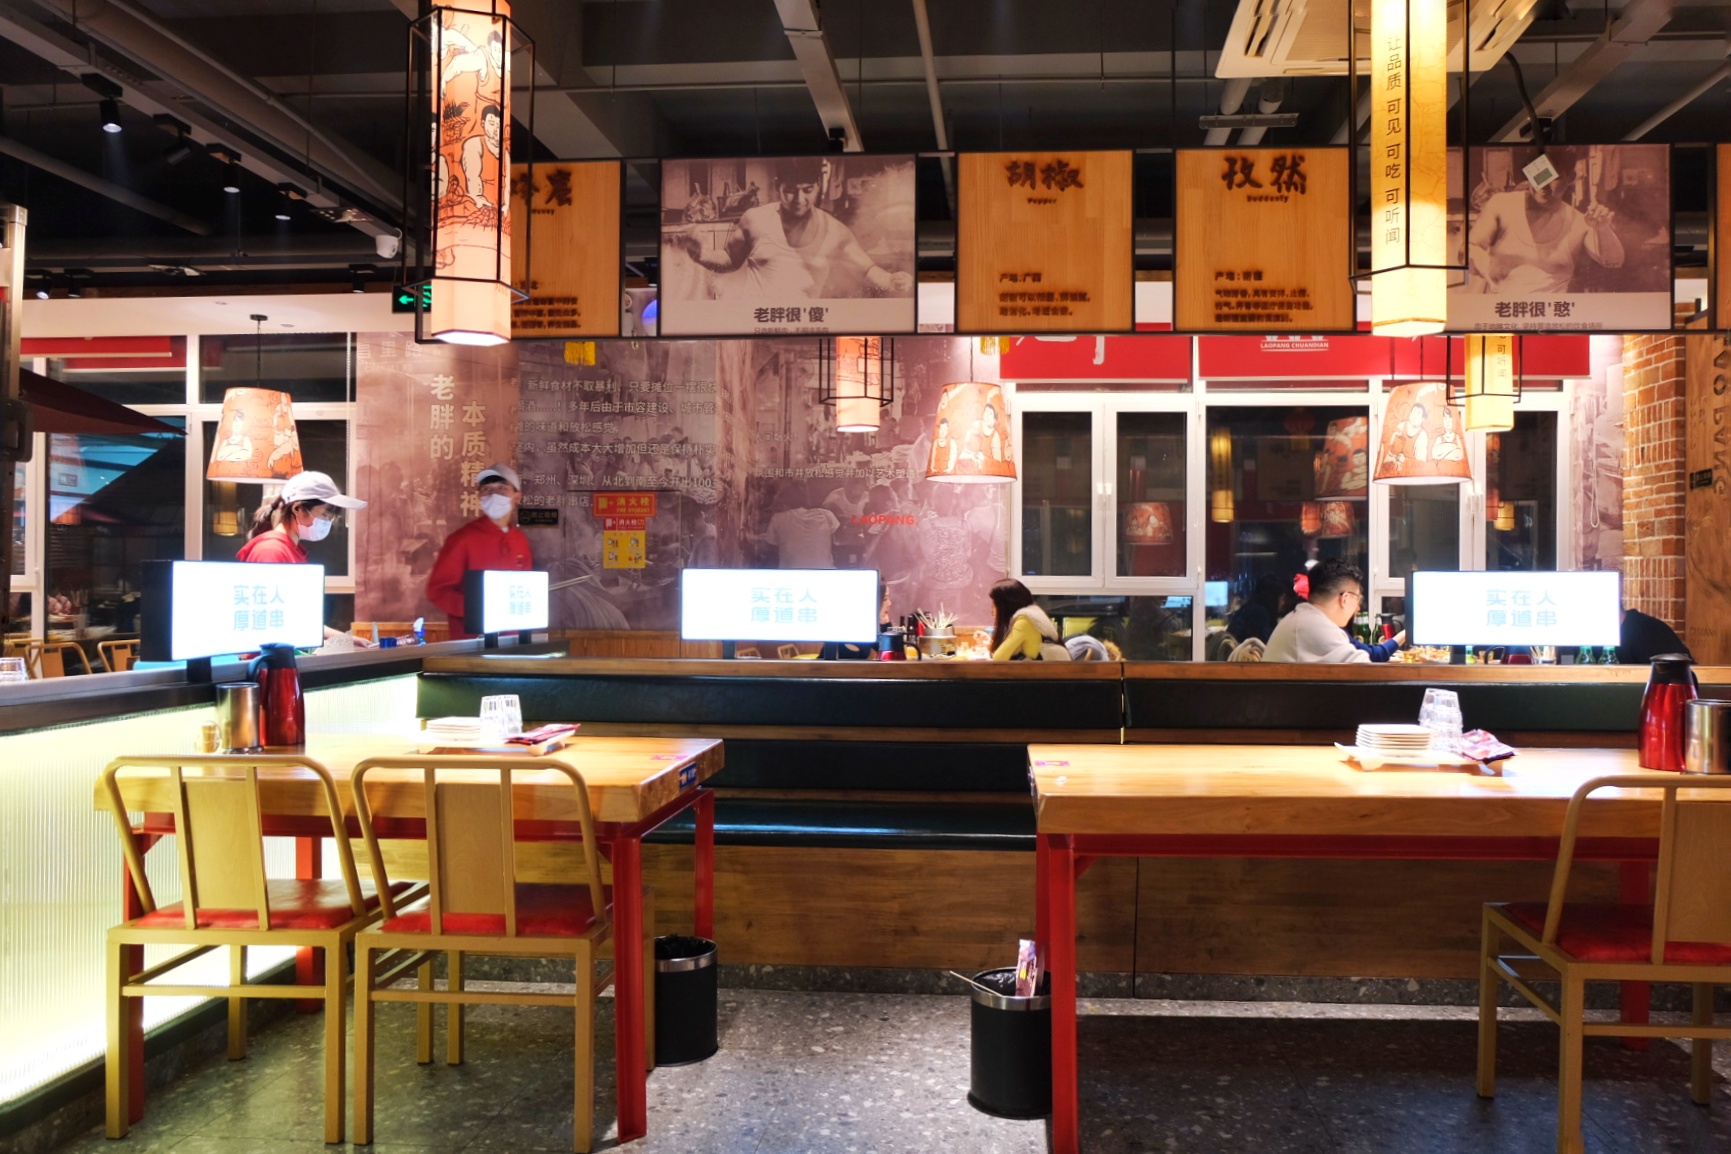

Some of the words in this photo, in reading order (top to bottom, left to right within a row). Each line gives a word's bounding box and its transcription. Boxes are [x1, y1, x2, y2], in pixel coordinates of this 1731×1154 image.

[1004, 160, 1084, 192] 胡椒
[1221, 155, 1307, 195] 孜然
[430, 374, 455, 461] 老胖的
[617, 497, 650, 506] 消火栓
[234, 584, 285, 605] 实在人
[751, 587, 817, 604] 实在人
[1486, 589, 1557, 607] 实在人
[233, 609, 285, 632] 厚道串
[750, 606, 818, 624] 厚道串
[1486, 609, 1557, 627] 厚道串
